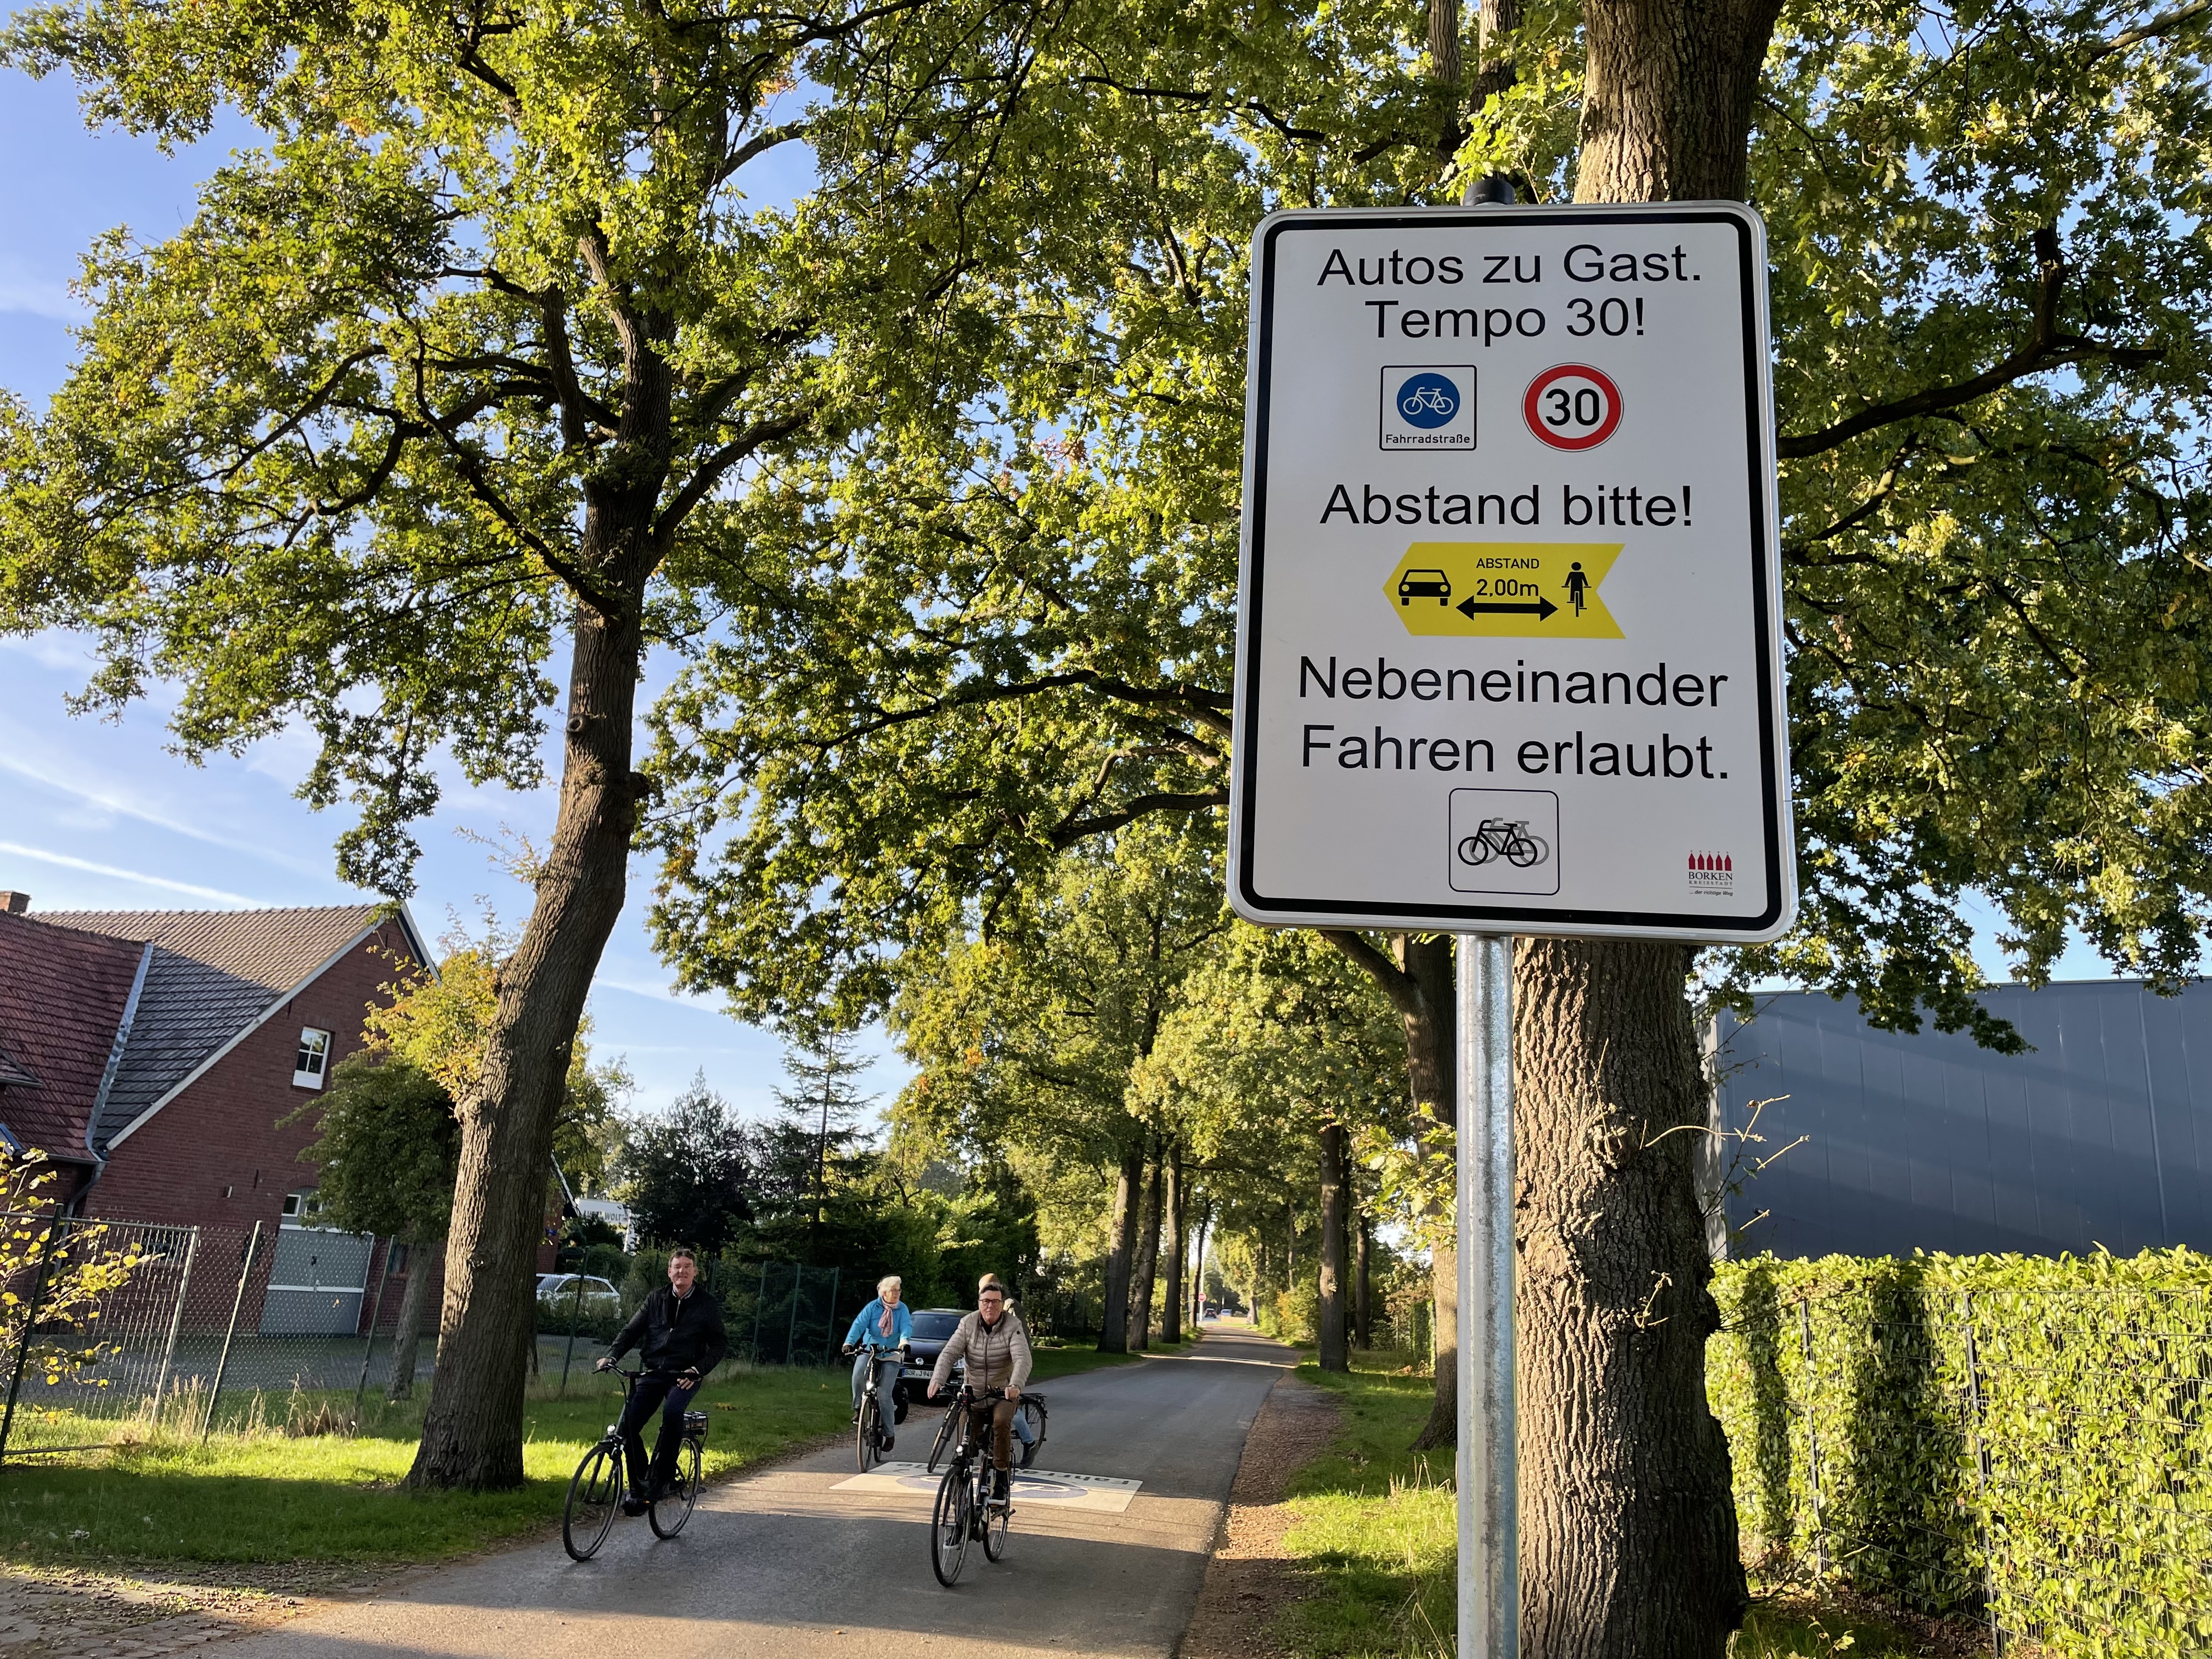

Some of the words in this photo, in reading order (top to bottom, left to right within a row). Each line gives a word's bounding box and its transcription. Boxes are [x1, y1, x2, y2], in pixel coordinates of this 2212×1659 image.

[1317, 249, 1464, 286] Autos
[1483, 255, 1541, 284] zu
[1564, 244, 1700, 283] Gast.
[1365, 300, 1545, 347] Tempo
[1566, 297, 1644, 337] 30!
[1545, 388, 1600, 426] 30
[1386, 434, 1470, 444] Fahrradstraße
[1319, 484, 1539, 525] Abstand
[1564, 484, 1691, 527] bitte!
[1476, 557, 1539, 569] ABSTAND
[1476, 578, 1539, 597] 2,00m
[1300, 656, 1729, 707] Nebeneinander
[1302, 724, 1494, 772] Fahren
[1517, 731, 1728, 779] erlaubt.
[1689, 871, 1733, 881] BORKEN
